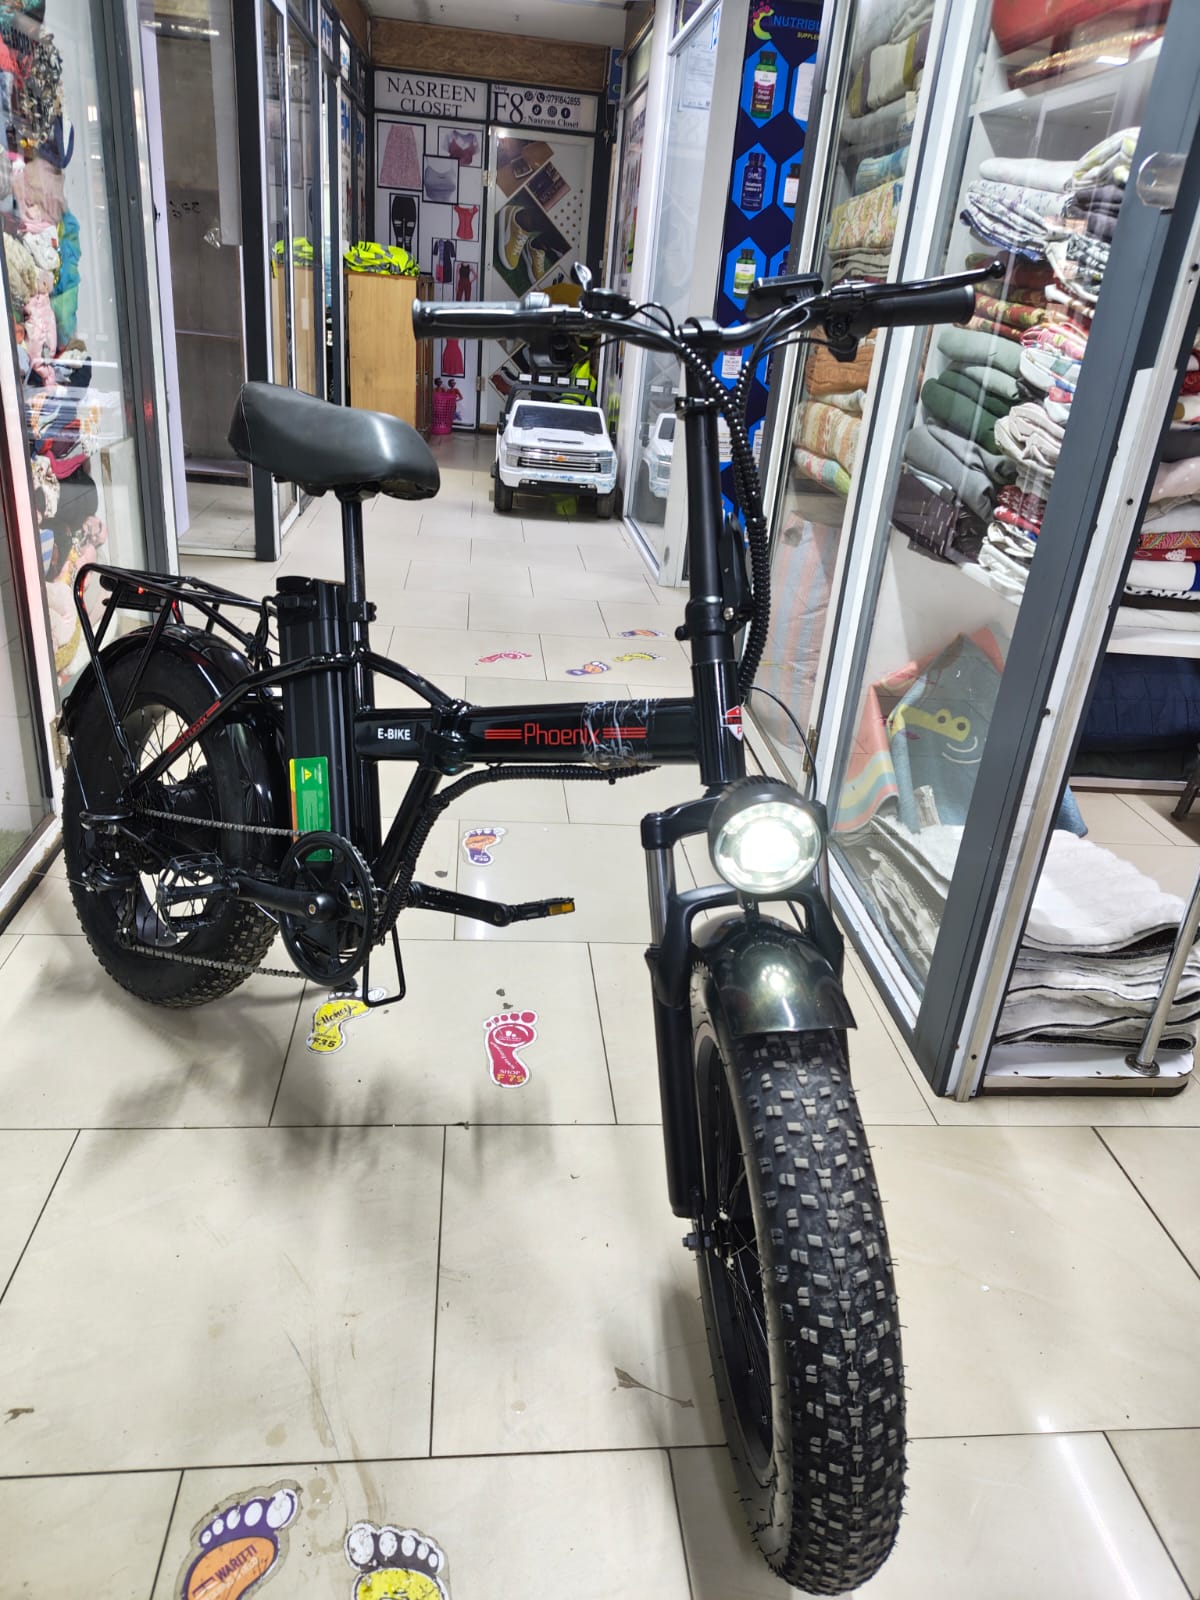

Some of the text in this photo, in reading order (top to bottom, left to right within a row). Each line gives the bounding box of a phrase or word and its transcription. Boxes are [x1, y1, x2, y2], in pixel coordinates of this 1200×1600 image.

[387, 76, 476, 103] NASREEN
[400, 97, 462, 117] CLOSET
[493, 91, 524, 125] F8
[528, 115, 556, 126] Nasreen
[557, 118, 580, 128] Closet
[377, 727, 411, 741] E-BIKE
[524, 722, 600, 745] Phoenix
